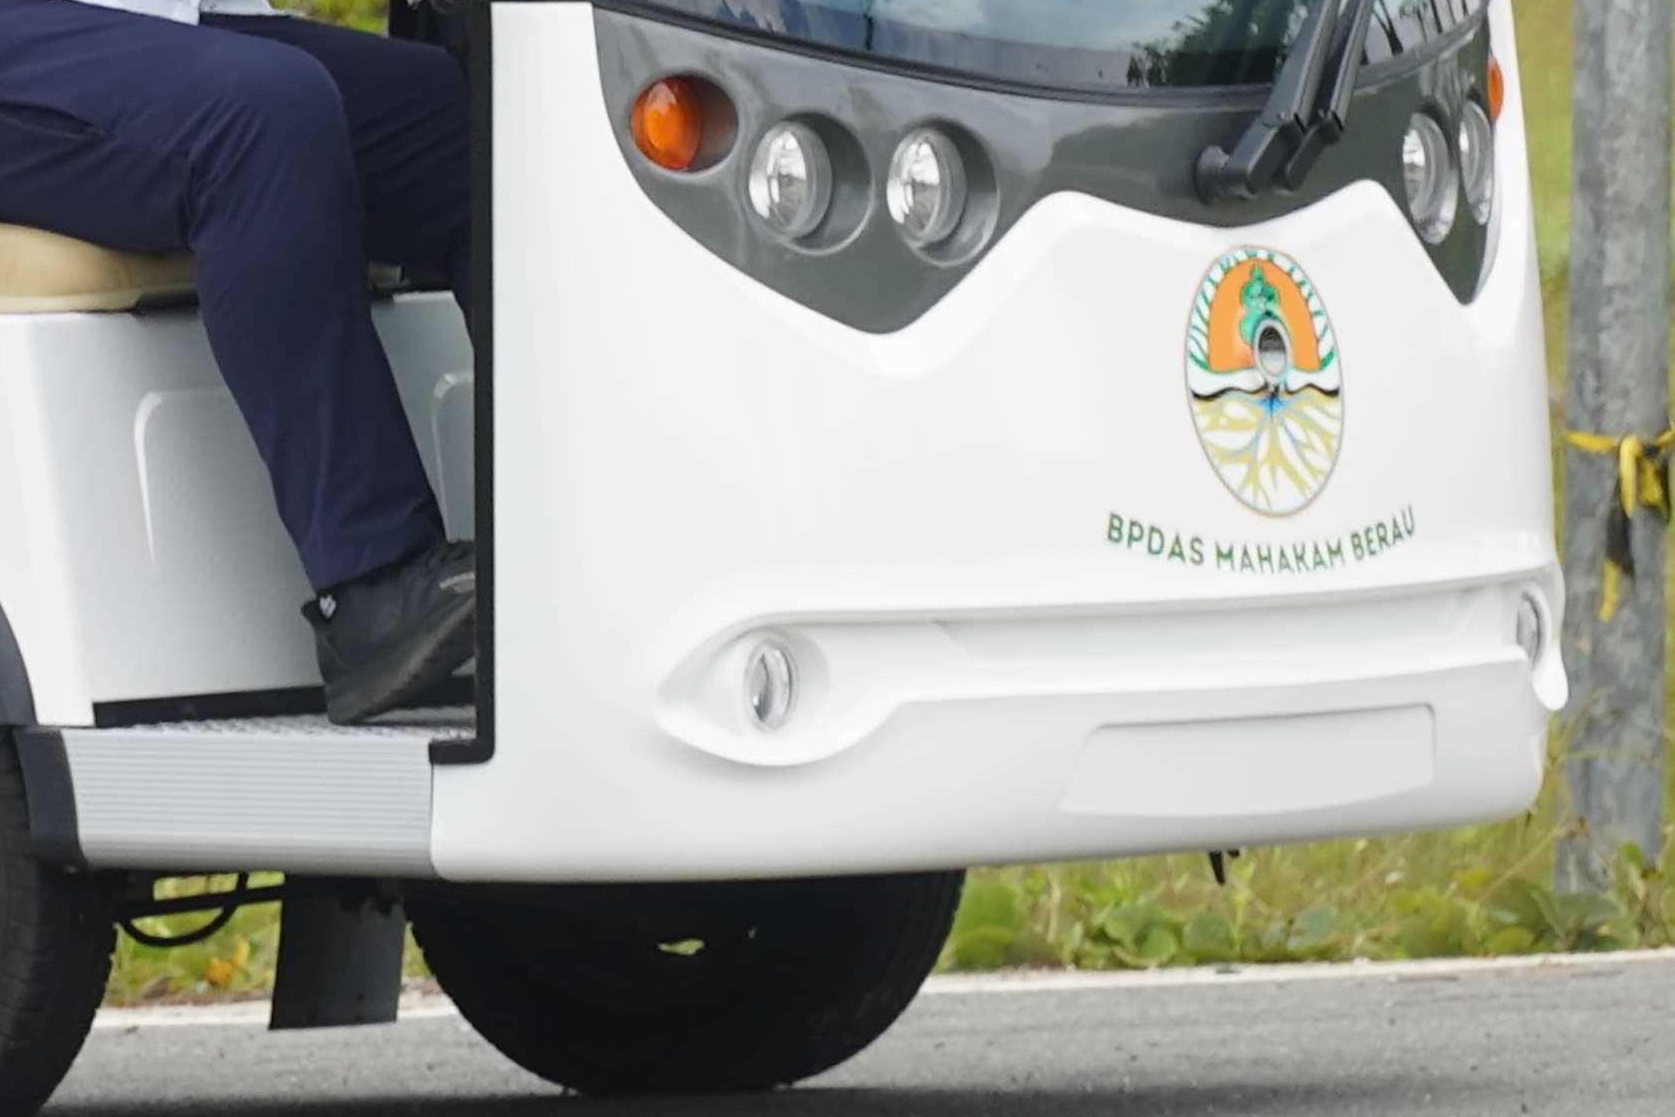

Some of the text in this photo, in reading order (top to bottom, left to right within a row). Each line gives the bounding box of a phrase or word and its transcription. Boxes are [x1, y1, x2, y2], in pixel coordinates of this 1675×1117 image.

[1106, 505, 1417, 575] BPDAS MAHAKAM BERAU
